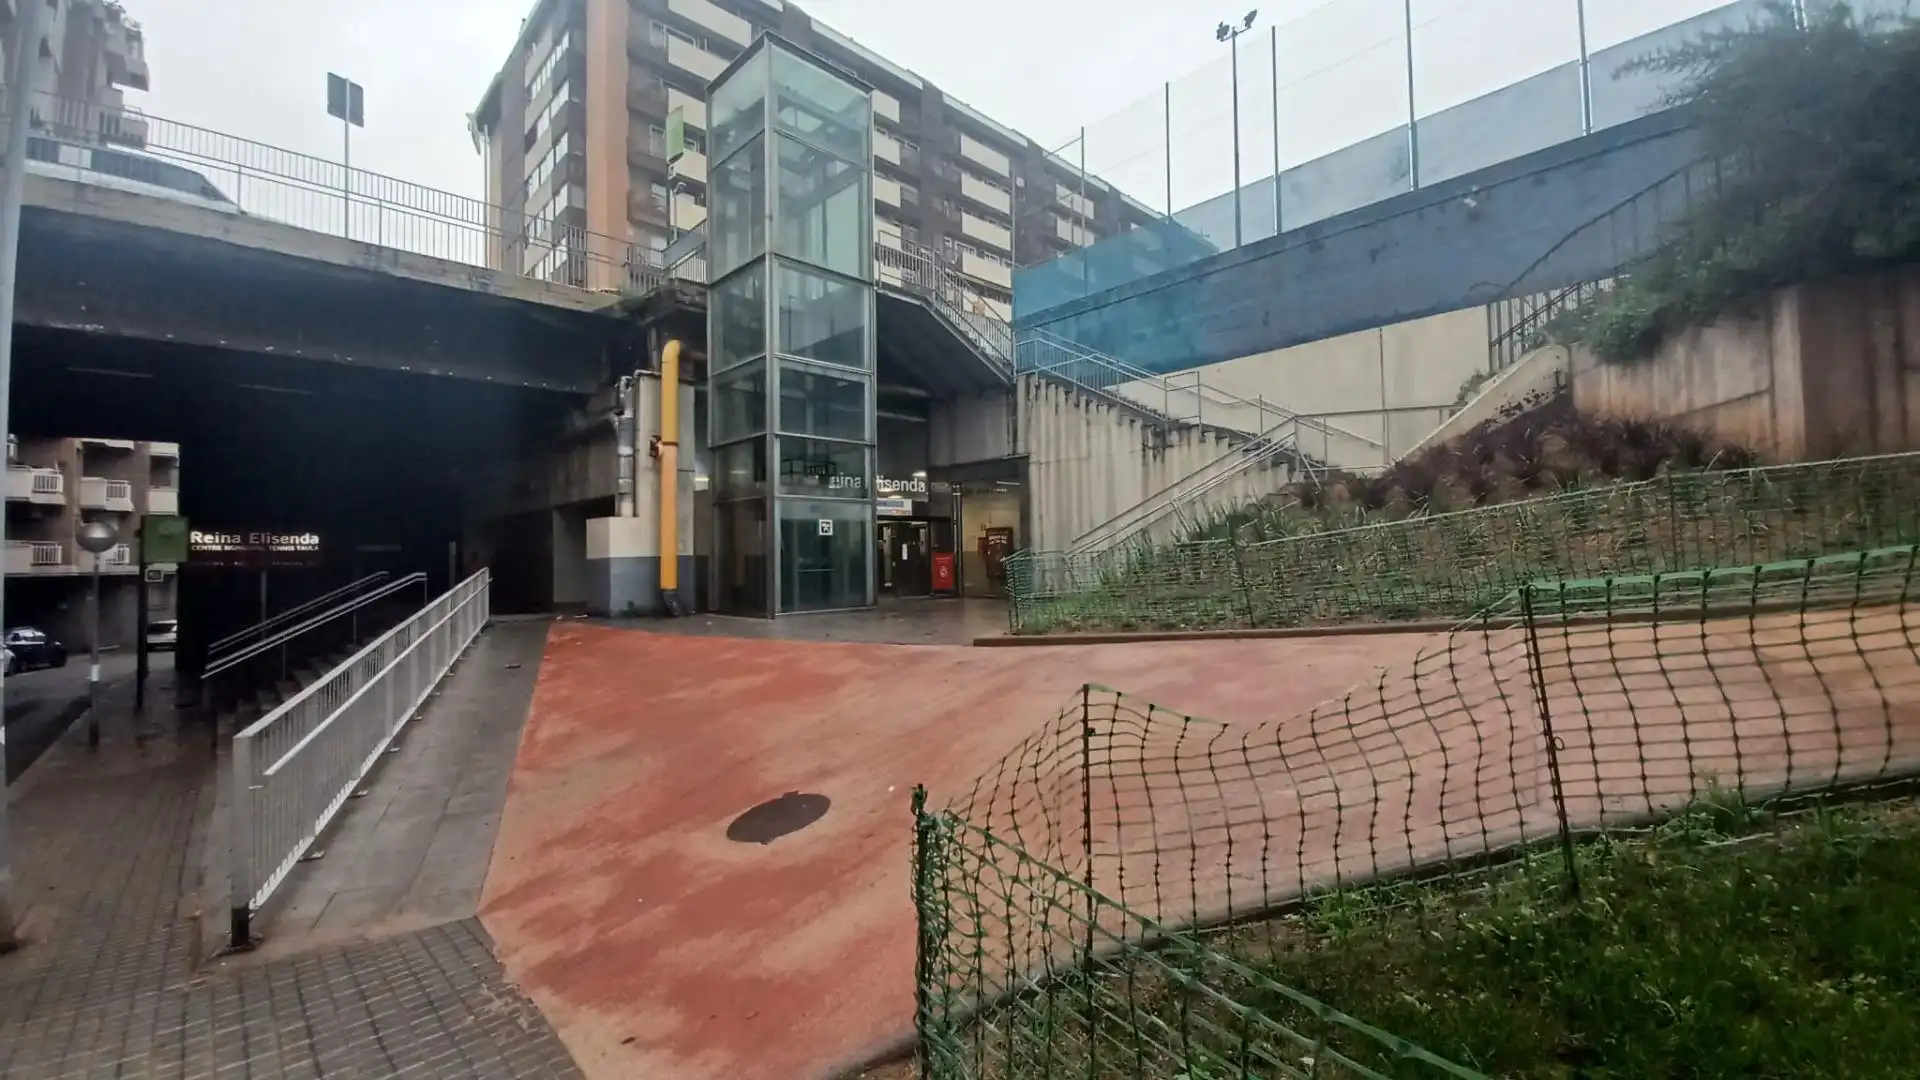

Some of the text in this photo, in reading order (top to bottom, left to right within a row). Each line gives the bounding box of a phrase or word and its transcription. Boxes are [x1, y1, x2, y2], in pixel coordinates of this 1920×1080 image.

[875, 474, 925, 492] lisenda
[190, 531, 320, 545] Reina Elisenda
